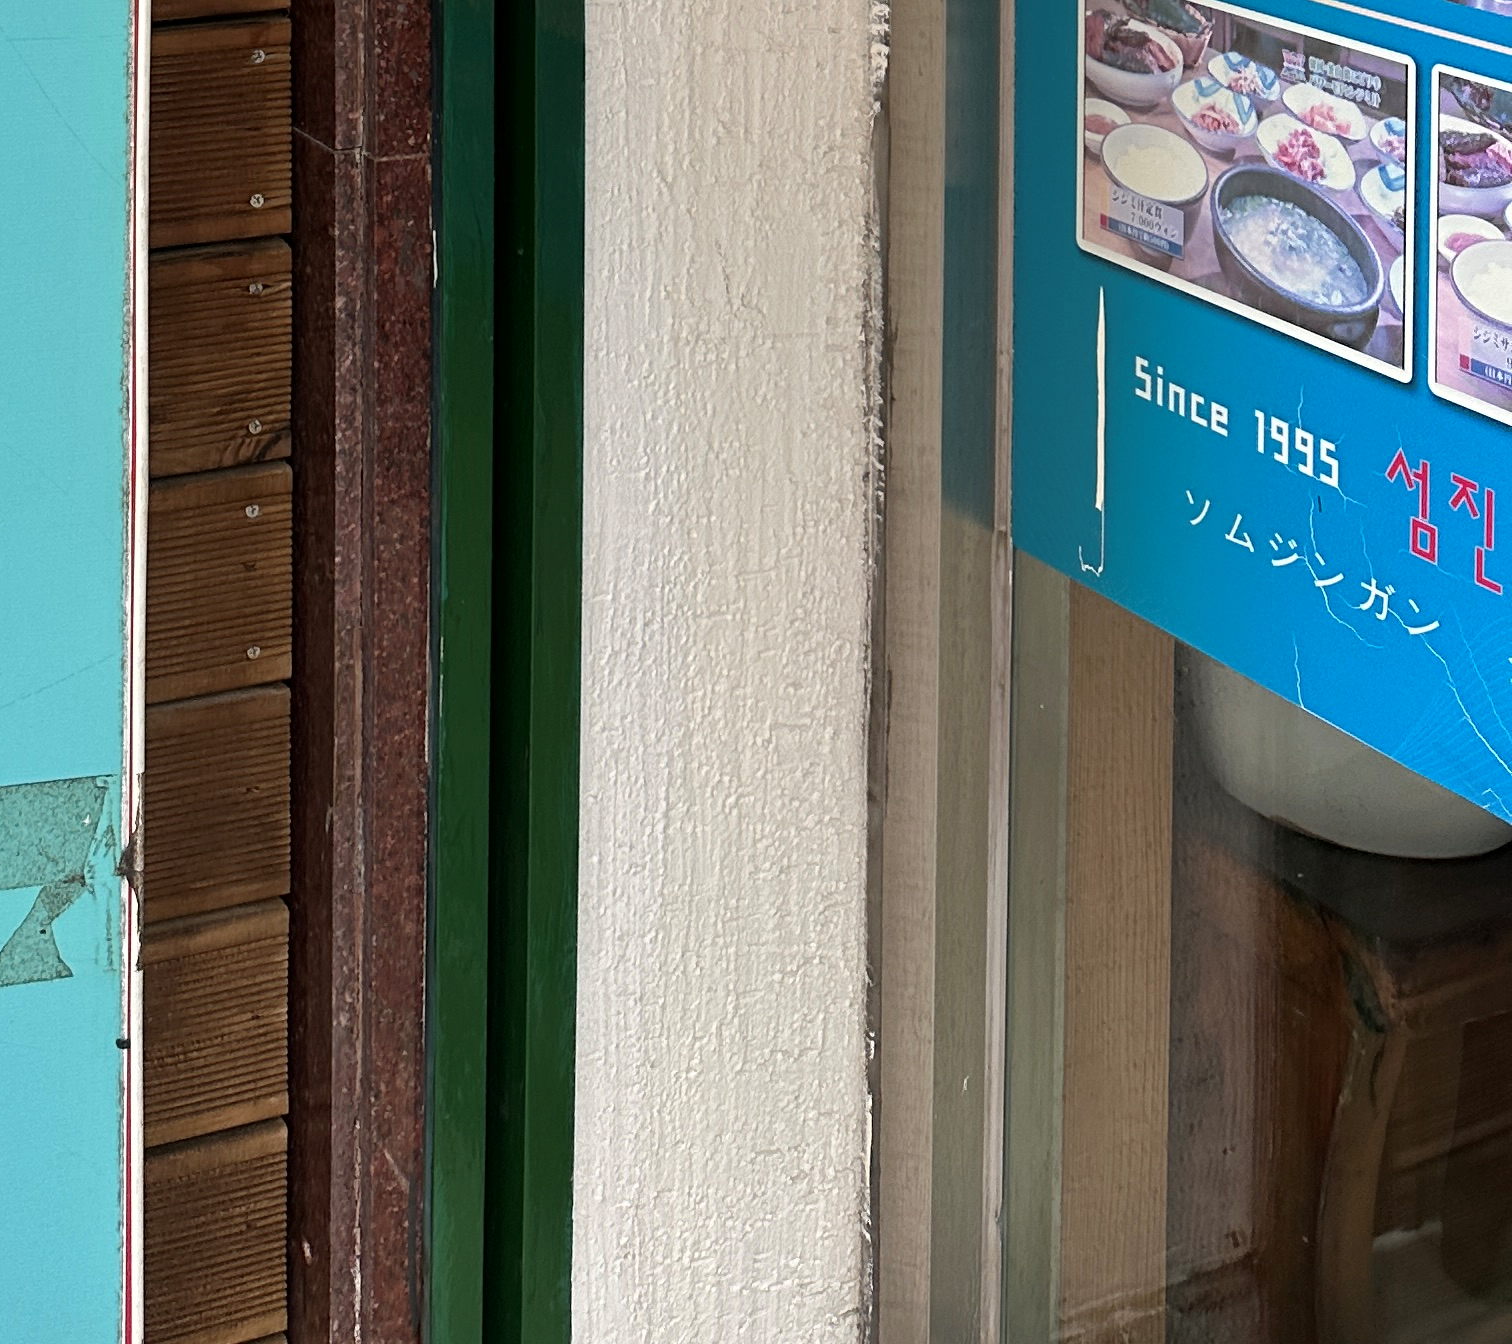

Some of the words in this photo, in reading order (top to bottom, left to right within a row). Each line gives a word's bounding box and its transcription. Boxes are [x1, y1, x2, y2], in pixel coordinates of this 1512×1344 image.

[1135, 355, 1229, 438] Since
[1254, 408, 1339, 488] 1995
[1186, 489, 1441, 635] ソムジンガン
[1385, 447, 1503, 596] 섬진
